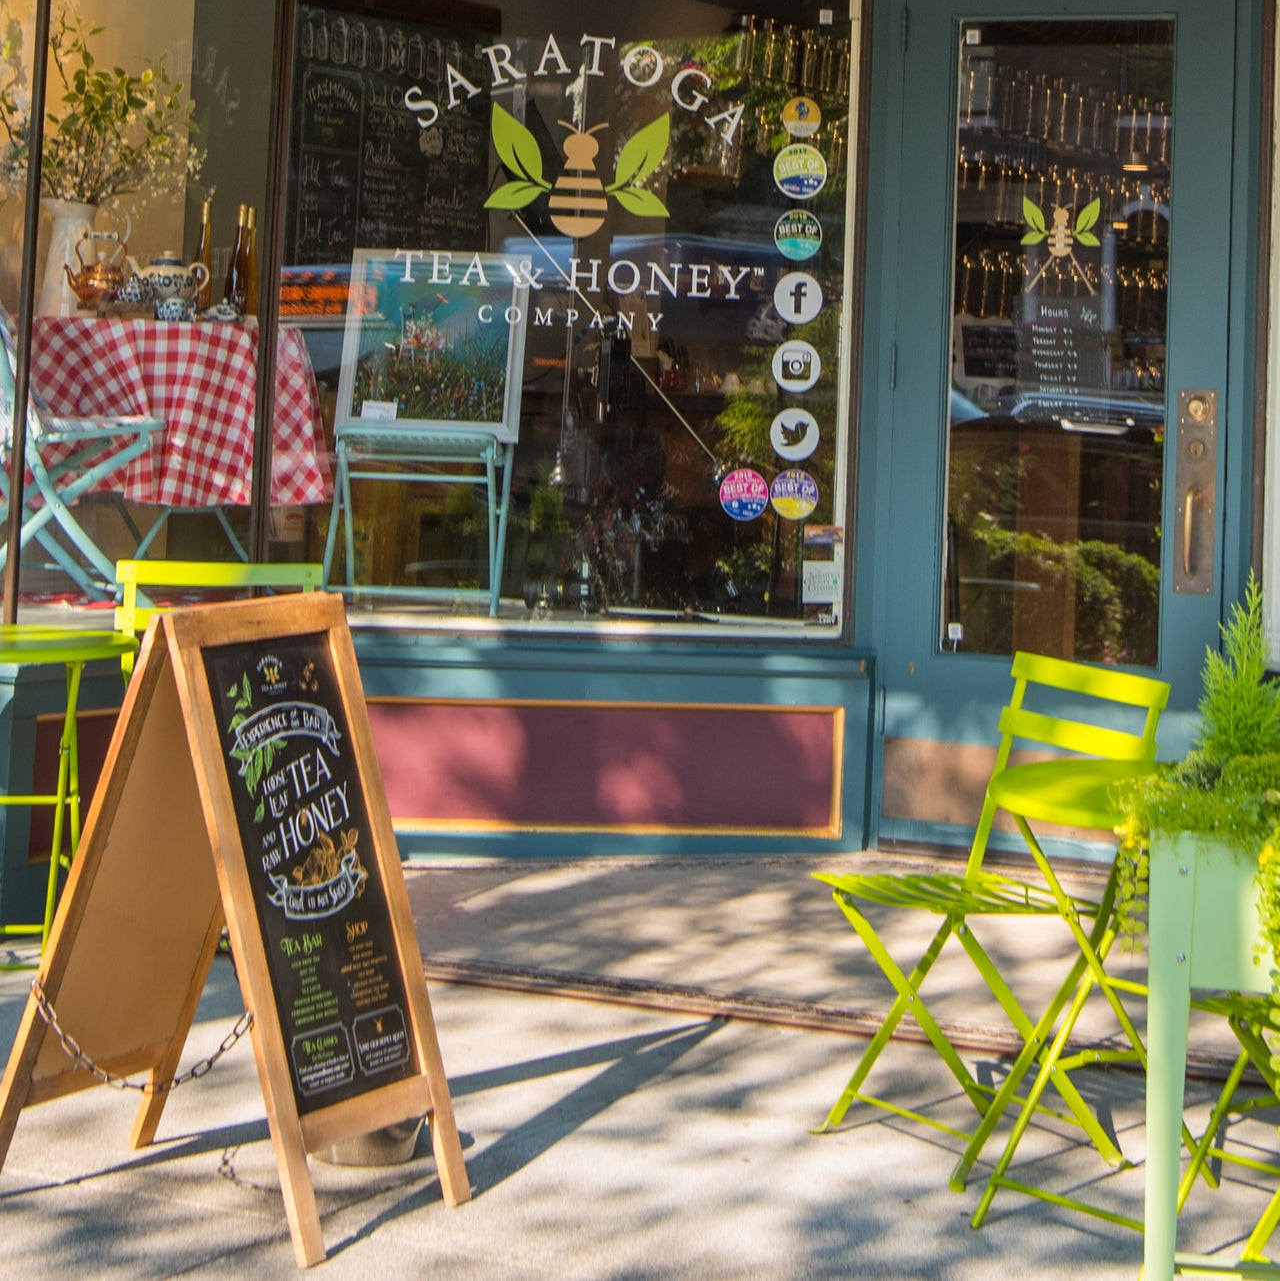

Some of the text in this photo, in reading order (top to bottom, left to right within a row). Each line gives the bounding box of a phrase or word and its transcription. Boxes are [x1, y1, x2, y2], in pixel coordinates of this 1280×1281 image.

[404, 33, 746, 147] SARATOGA
[778, 159, 804, 173] BEST
[778, 222, 819, 235] BEST OF
[394, 248, 490, 286] TEA
[513, 260, 544, 291] &
[477, 304, 664, 332] COMPANY
[723, 481, 764, 494] BEST OF
[774, 481, 815, 495] BEST OF
[262, 747, 332, 799] LOOSE TEA
[269, 790, 289, 818] LEAF
[278, 780, 350, 860] HONEY
[262, 845, 282, 873] RAW
